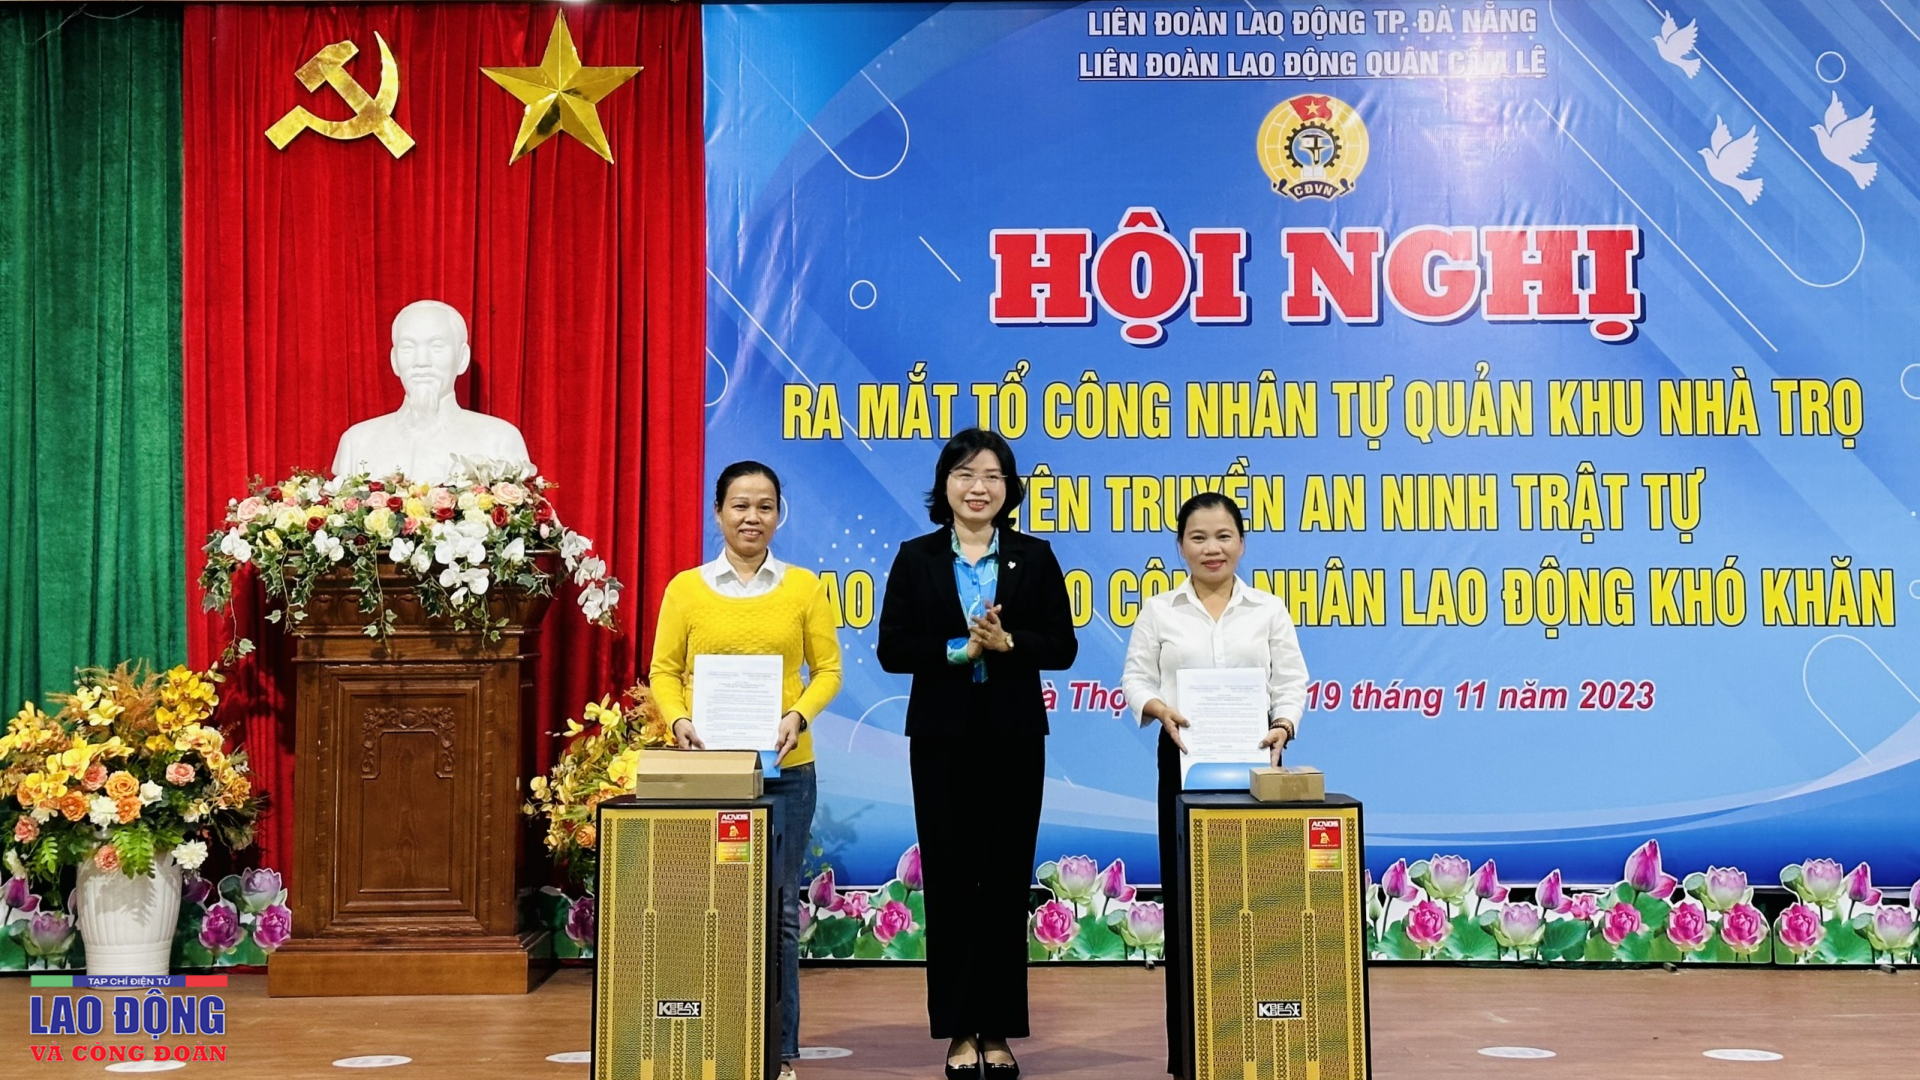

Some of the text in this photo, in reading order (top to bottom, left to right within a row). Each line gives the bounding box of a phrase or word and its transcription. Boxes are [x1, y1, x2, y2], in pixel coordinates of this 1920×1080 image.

[1088, 0, 1537, 40] LIÊN ĐOÀN LAO ĐỘNG TP. ĐÀ NẴNG
[1079, 47, 1137, 77] LIÊN
[1146, 47, 1218, 77] ĐOÀN
[1227, 52, 1276, 77] LAO
[1284, 47, 1356, 80] ĐỘNG
[1365, 46, 1438, 79] QUẬN
[1516, 44, 1547, 79] LỆ
[1293, 184, 1333, 196] CĐVN
[990, 206, 1643, 345] HỘI NGHỊ
[782, 359, 1864, 450] RA MẮT TỔ CÔNG NHÂN TỰ QUẢN KHU NHÀ TRỌ
[1299, 474, 1366, 532] AN
[1381, 474, 1499, 532] NINH
[1512, 461, 1629, 544] TRẬT
[1642, 466, 1706, 544] TỰ
[1400, 567, 1487, 627] LAO
[1501, 555, 1634, 639] ĐỘNG
[1650, 556, 1746, 627] KHÓ
[1761, 556, 1895, 627] KHĂN
[1069, 680, 1127, 718] Thọ
[1305, 680, 1341, 711] 19
[1351, 679, 1444, 718] tháng
[1455, 679, 1487, 711] 11
[1497, 679, 1569, 711] năm
[1578, 680, 1655, 711] 2023
